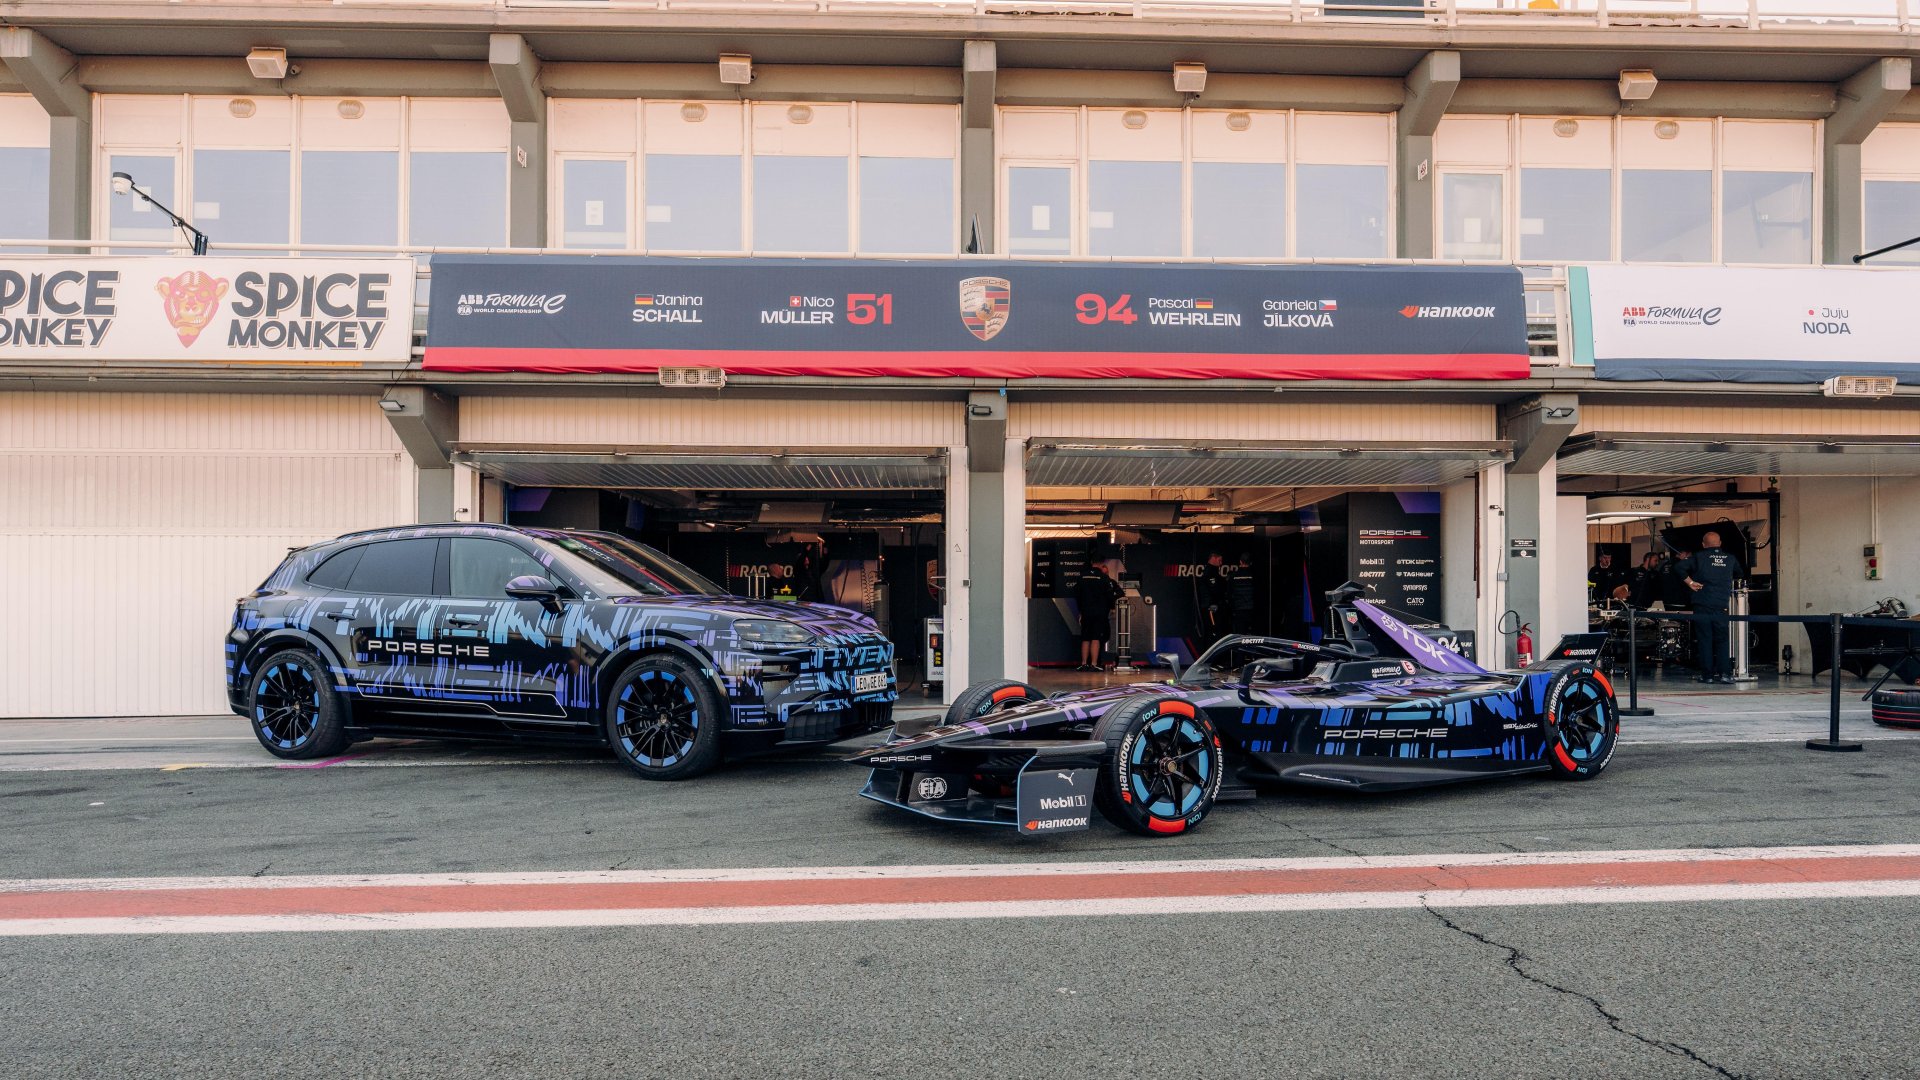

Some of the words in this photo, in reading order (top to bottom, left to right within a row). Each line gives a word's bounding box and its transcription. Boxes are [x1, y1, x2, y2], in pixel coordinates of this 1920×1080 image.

[962, 279, 1008, 288] PORSCHE
[231, 271, 390, 317] SPICE
[458, 294, 484, 305] ABB
[484, 293, 546, 307] FORMULA
[655, 294, 703, 306] Janina
[803, 296, 835, 307] Nico
[1148, 297, 1194, 309] Pascal
[1262, 300, 1317, 311] Gabriela
[632, 309, 703, 323] SCHALL
[760, 308, 834, 324] MÜLLER
[847, 293, 893, 325] 51
[1075, 293, 1138, 325] 94
[1622, 306, 1646, 317] ABB
[1646, 306, 1703, 319] FORMULA
[1821, 307, 1849, 320] Juju
[1148, 312, 1241, 327] WEHRLEIN
[228, 319, 384, 349] MONKEY
[1803, 321, 1852, 335] NODA
[1402, 584, 1428, 592] SYNOPSYS
[367, 640, 490, 657] PORSCHE
[1395, 621, 1449, 667] TDK
[1323, 727, 1449, 739] PORSCHE
[870, 754, 932, 763] PORSCHE
[919, 780, 946, 796] FIA
[1039, 796, 1075, 810] Mobil
